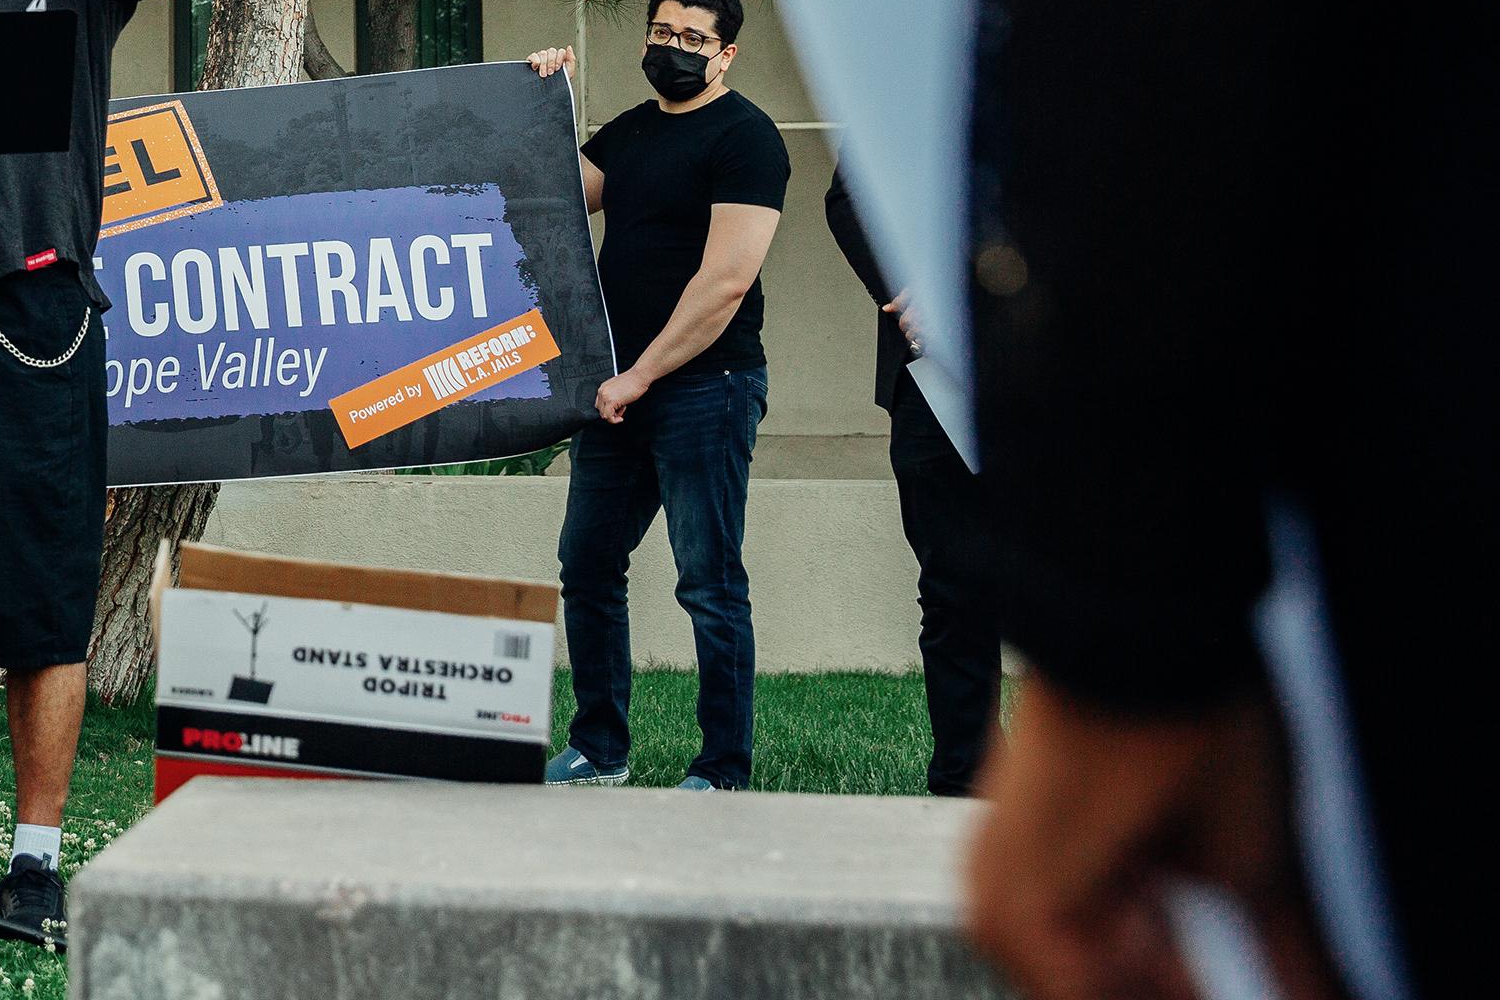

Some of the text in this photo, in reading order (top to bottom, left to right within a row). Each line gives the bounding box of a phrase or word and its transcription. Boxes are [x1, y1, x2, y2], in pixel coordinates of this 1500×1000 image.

[102, 138, 181, 197] EL
[124, 232, 493, 337] CONTRACT
[106, 337, 328, 408] ope Valley
[465, 351, 522, 384] L.A. JAILS
[348, 383, 423, 424] Powered by
[293, 647, 513, 684] ORCHESTRA STAND
[364, 677, 447, 701] TRIPOD
[182, 727, 300, 759] PROLINE
